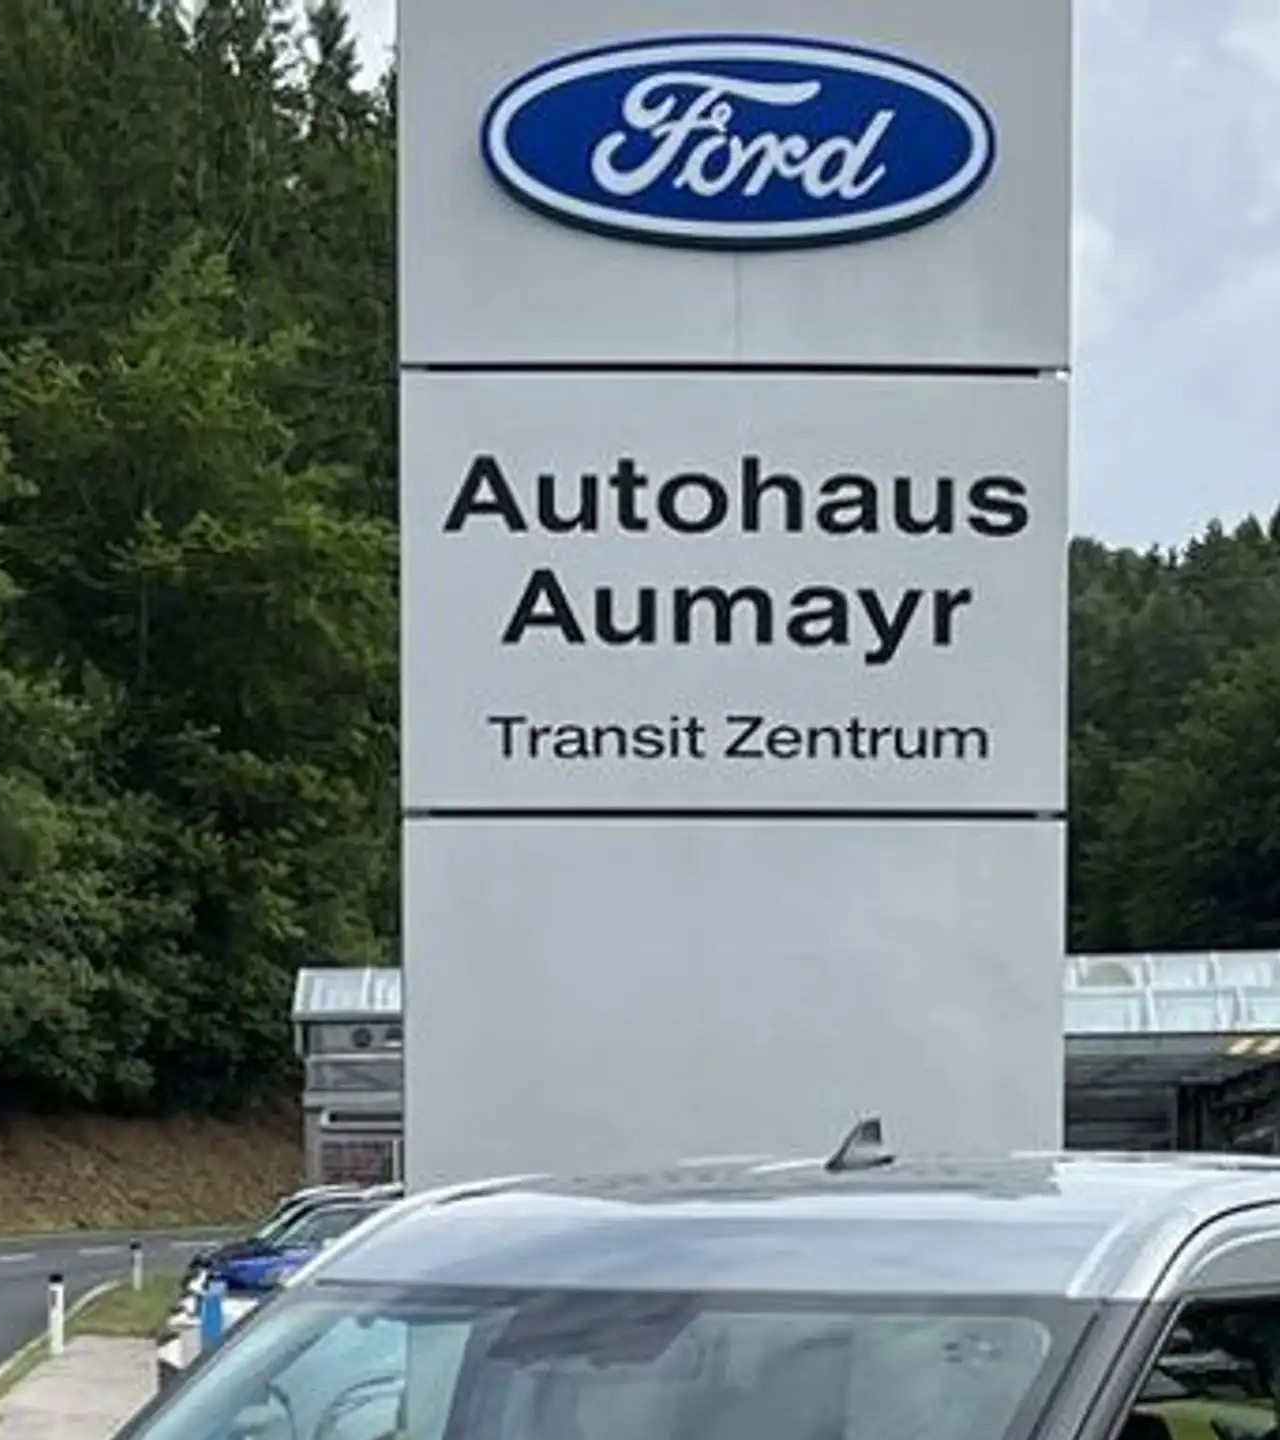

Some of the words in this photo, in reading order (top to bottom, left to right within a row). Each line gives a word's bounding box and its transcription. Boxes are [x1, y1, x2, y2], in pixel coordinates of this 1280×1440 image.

[590, 70, 895, 200] Ford
[443, 456, 1029, 537] Autohaus
[502, 569, 972, 664] Aumayr
[489, 716, 707, 760] Transit
[725, 716, 990, 760] Zentrum
